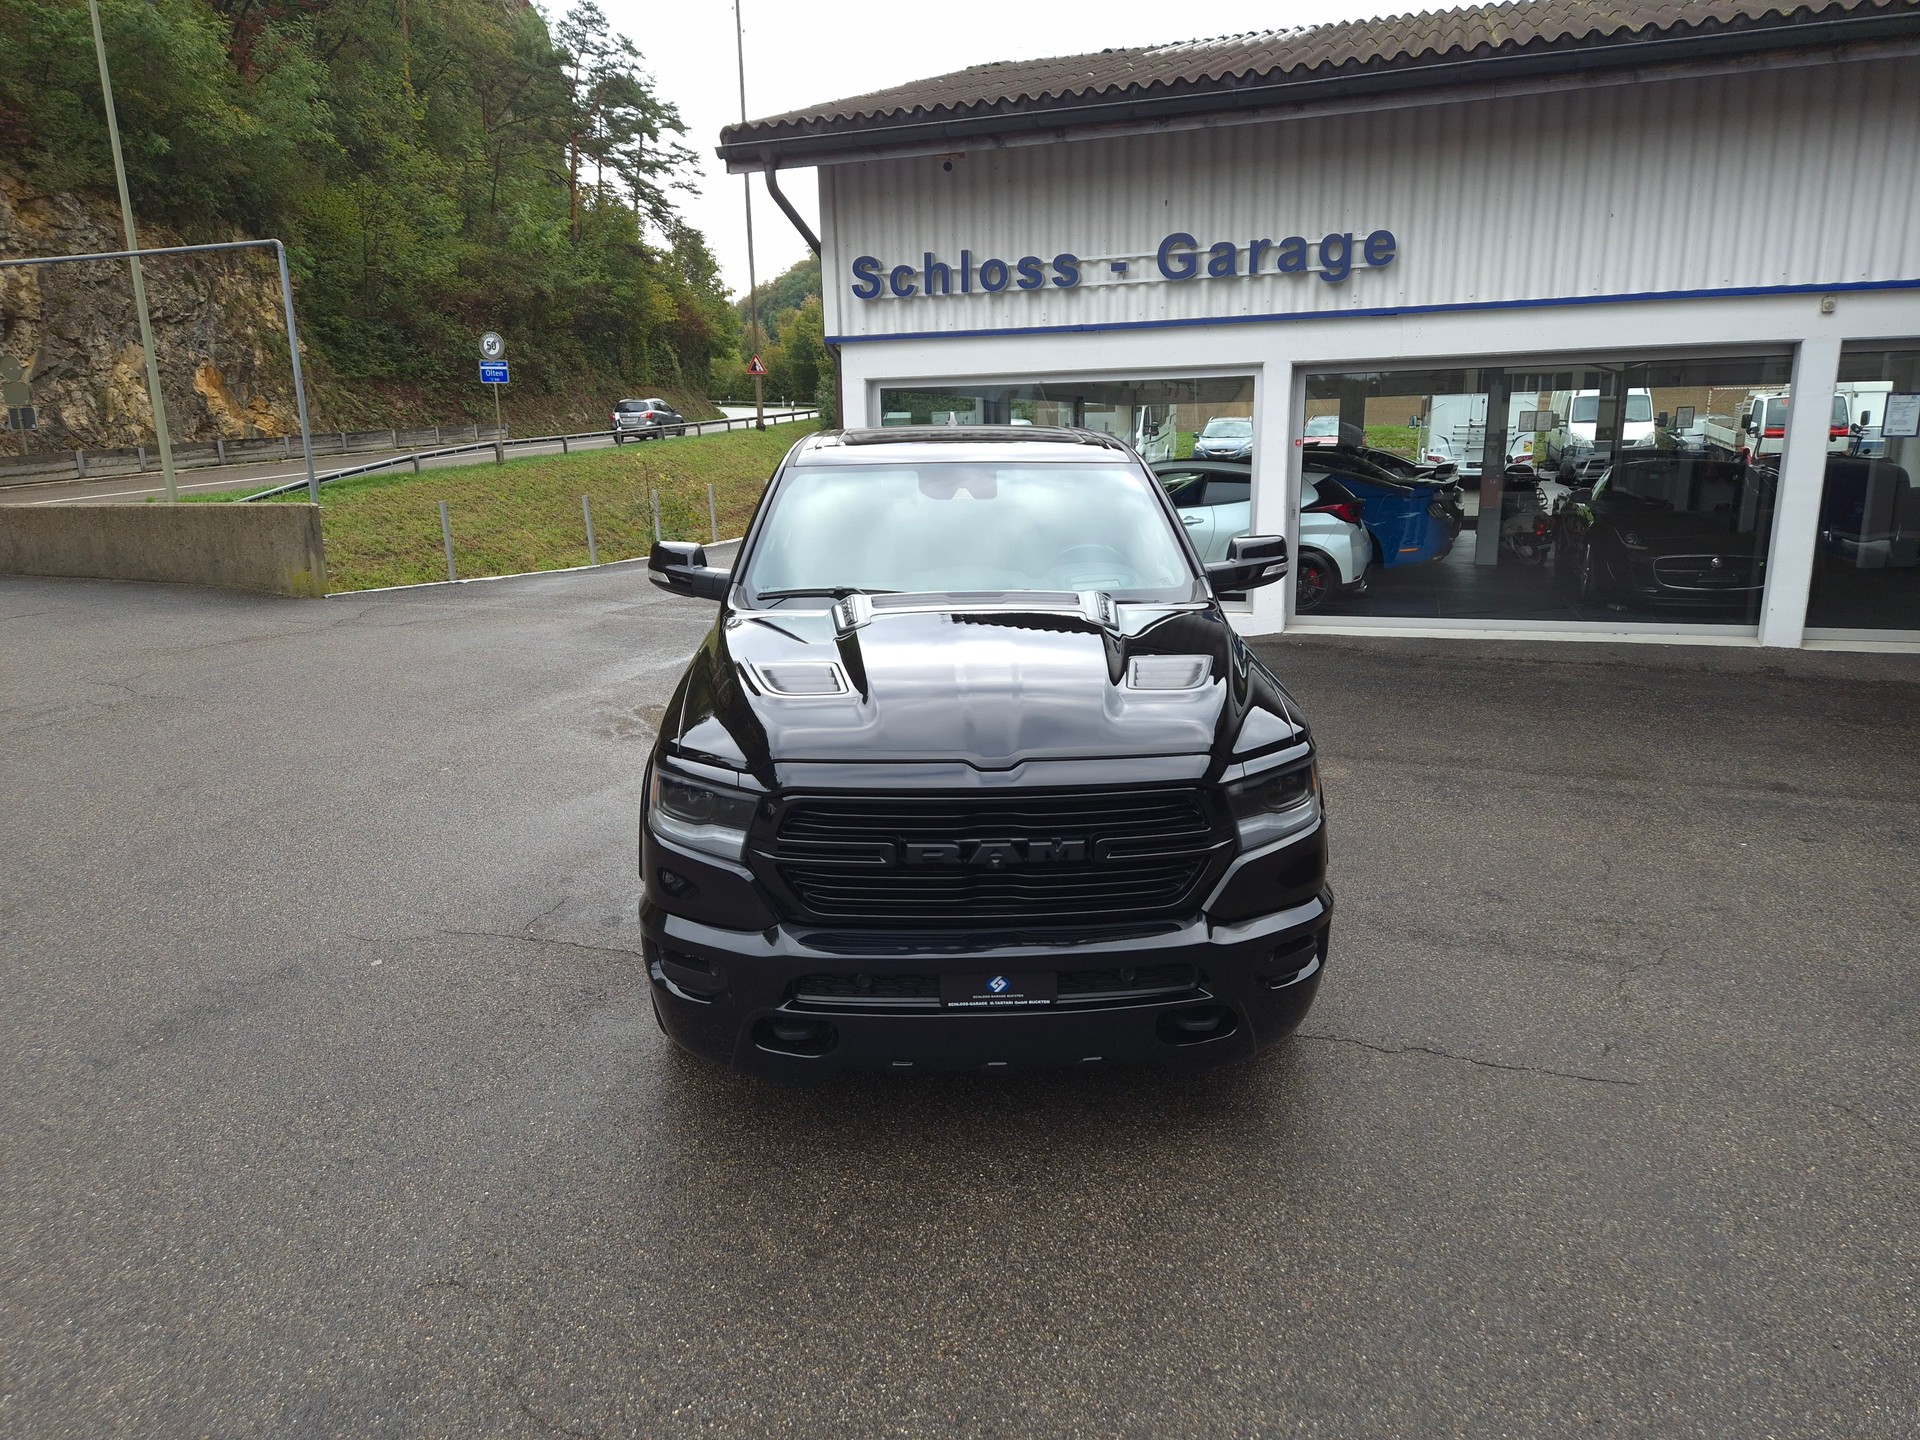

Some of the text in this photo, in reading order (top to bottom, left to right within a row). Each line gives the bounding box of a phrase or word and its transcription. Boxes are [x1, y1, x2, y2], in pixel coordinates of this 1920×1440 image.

[851, 248, 1081, 300] Schloss
[1156, 229, 1397, 283] Garage
[486, 341, 497, 351] 50
[485, 369, 504, 377] Olten
[904, 839, 1086, 865] RAM
